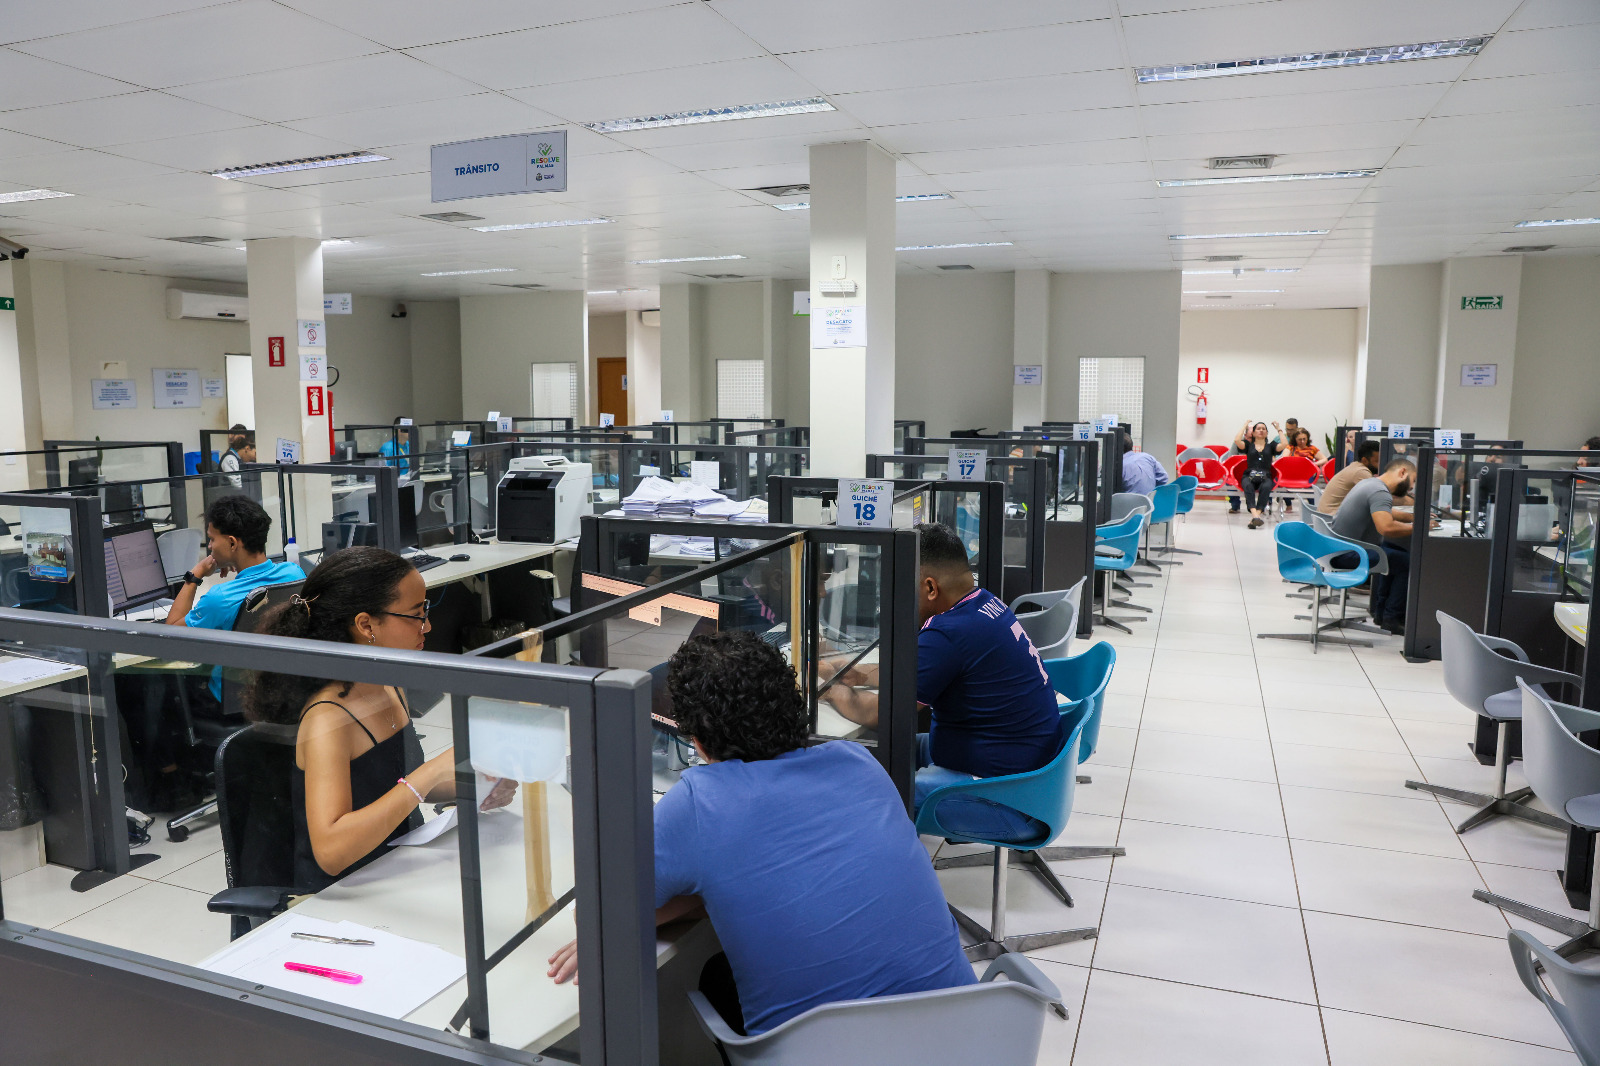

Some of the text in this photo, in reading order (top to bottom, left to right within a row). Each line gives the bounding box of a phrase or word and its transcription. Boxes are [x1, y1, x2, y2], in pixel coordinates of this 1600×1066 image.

[531, 156, 560, 164] RESOLVE
[455, 163, 499, 176] TRÂNSITO
[1441, 438, 1454, 446] 23
[959, 464, 975, 475] 17
[854, 503, 875, 520] 18
